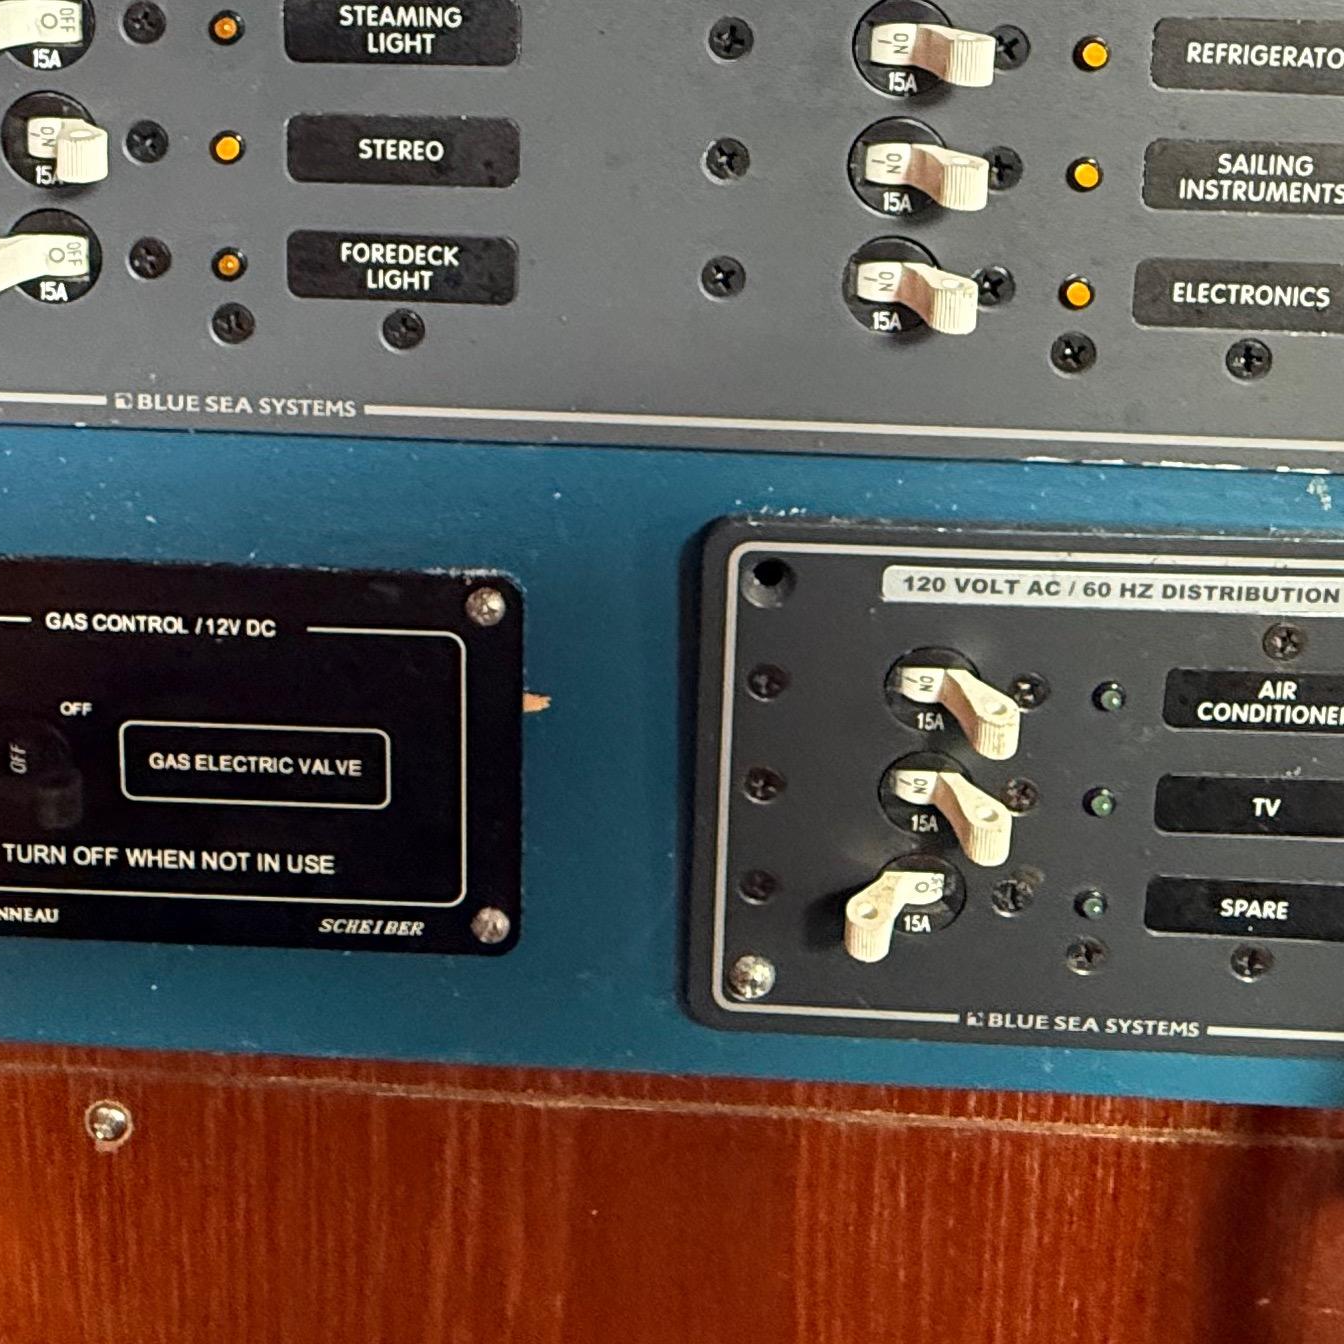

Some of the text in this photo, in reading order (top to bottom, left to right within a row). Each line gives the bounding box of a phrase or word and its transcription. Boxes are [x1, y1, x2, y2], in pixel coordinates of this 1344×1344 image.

[339, 4, 463, 29] STEAMING
[367, 32, 436, 55] LIGHT
[32, 48, 62, 70] 15A
[888, 72, 918, 93] 15A
[358, 138, 445, 162] STEREO
[1217, 153, 1314, 178] SAILING
[883, 191, 913, 212] 15A
[341, 242, 460, 266] FOREDECK
[366, 268, 434, 291] LIGHT
[39, 281, 68, 302] 15A
[1172, 281, 1331, 308] ELECTRONICS
[872, 311, 902, 331] 15A
[137, 393, 357, 418] BLUE SEA SYSTEMS
[903, 575, 1341, 604] 120 VOLT AC / 60 HZ DISTRIBUTION
[45, 612, 89, 632] GAS
[92, 613, 190, 635] CONTROL
[246, 619, 277, 638] DC
[1257, 680, 1298, 701] AIR
[59, 701, 93, 716] OFF
[917, 712, 945, 731] 15A
[9, 742, 28, 775] OFF
[148, 752, 362, 777] GAS ELECTRIC VALVE
[1252, 797, 1282, 817] TV
[911, 814, 938, 832] 15A
[2, 843, 336, 875] TURN OFF WHEN NOT IN USE
[1220, 898, 1289, 920] SPARE
[317, 918, 426, 937] SCHEIBER
[903, 914, 932, 933] 15A
[988, 1011, 1200, 1038] BLUE SEA SYSTEMS
